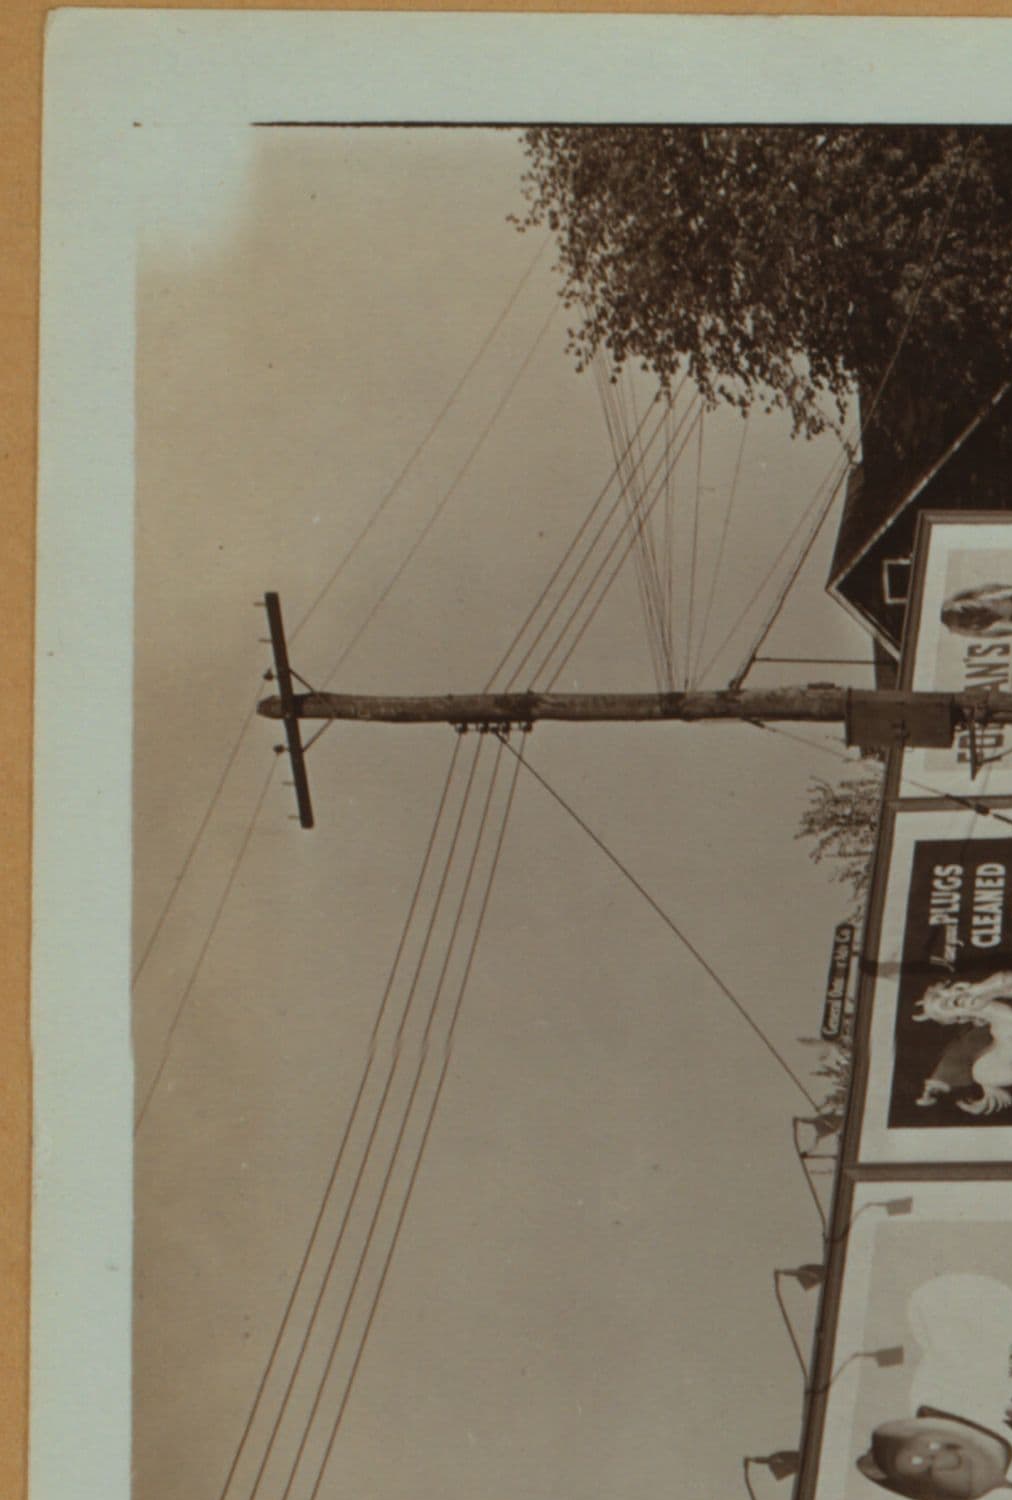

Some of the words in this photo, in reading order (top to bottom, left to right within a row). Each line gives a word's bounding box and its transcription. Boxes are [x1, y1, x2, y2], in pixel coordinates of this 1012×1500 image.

[956, 643, 1010, 763] FOAN'S
[928, 864, 963, 925] PLUGS
[970, 862, 1006, 948] CLEANED
